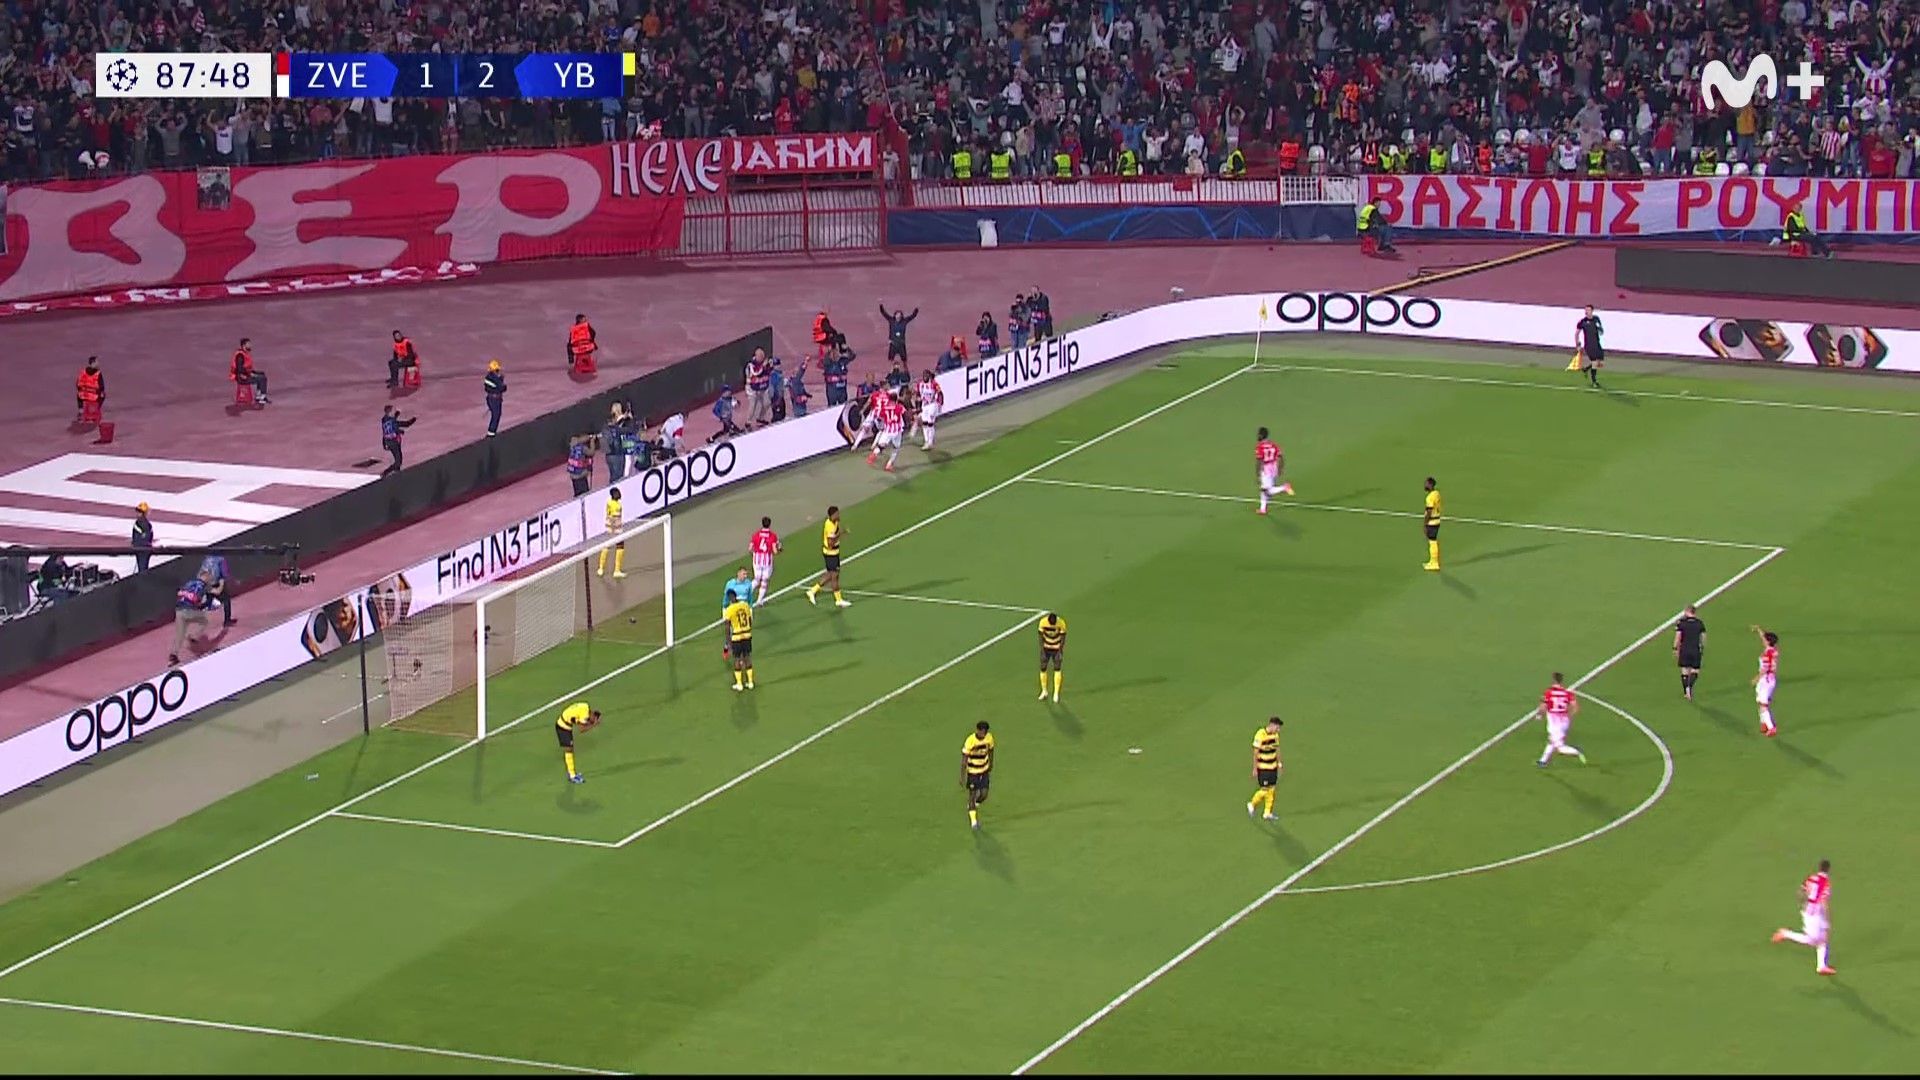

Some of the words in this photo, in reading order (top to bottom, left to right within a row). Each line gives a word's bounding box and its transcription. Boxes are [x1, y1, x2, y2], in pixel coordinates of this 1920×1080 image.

[1677, 177, 1920, 232] ΡΟΥΜΠ
[1276, 292, 1442, 333] oppo
[965, 358, 1009, 400] Find
[1014, 345, 1042, 385] N3
[1047, 334, 1080, 374] Flip
[641, 442, 736, 506] oppo
[437, 539, 485, 595] Find
[490, 523, 521, 573] N3
[526, 511, 562, 556] Flip
[759, 538, 768, 552] 4
[737, 609, 748, 628] 13
[66, 669, 189, 752] oppo
